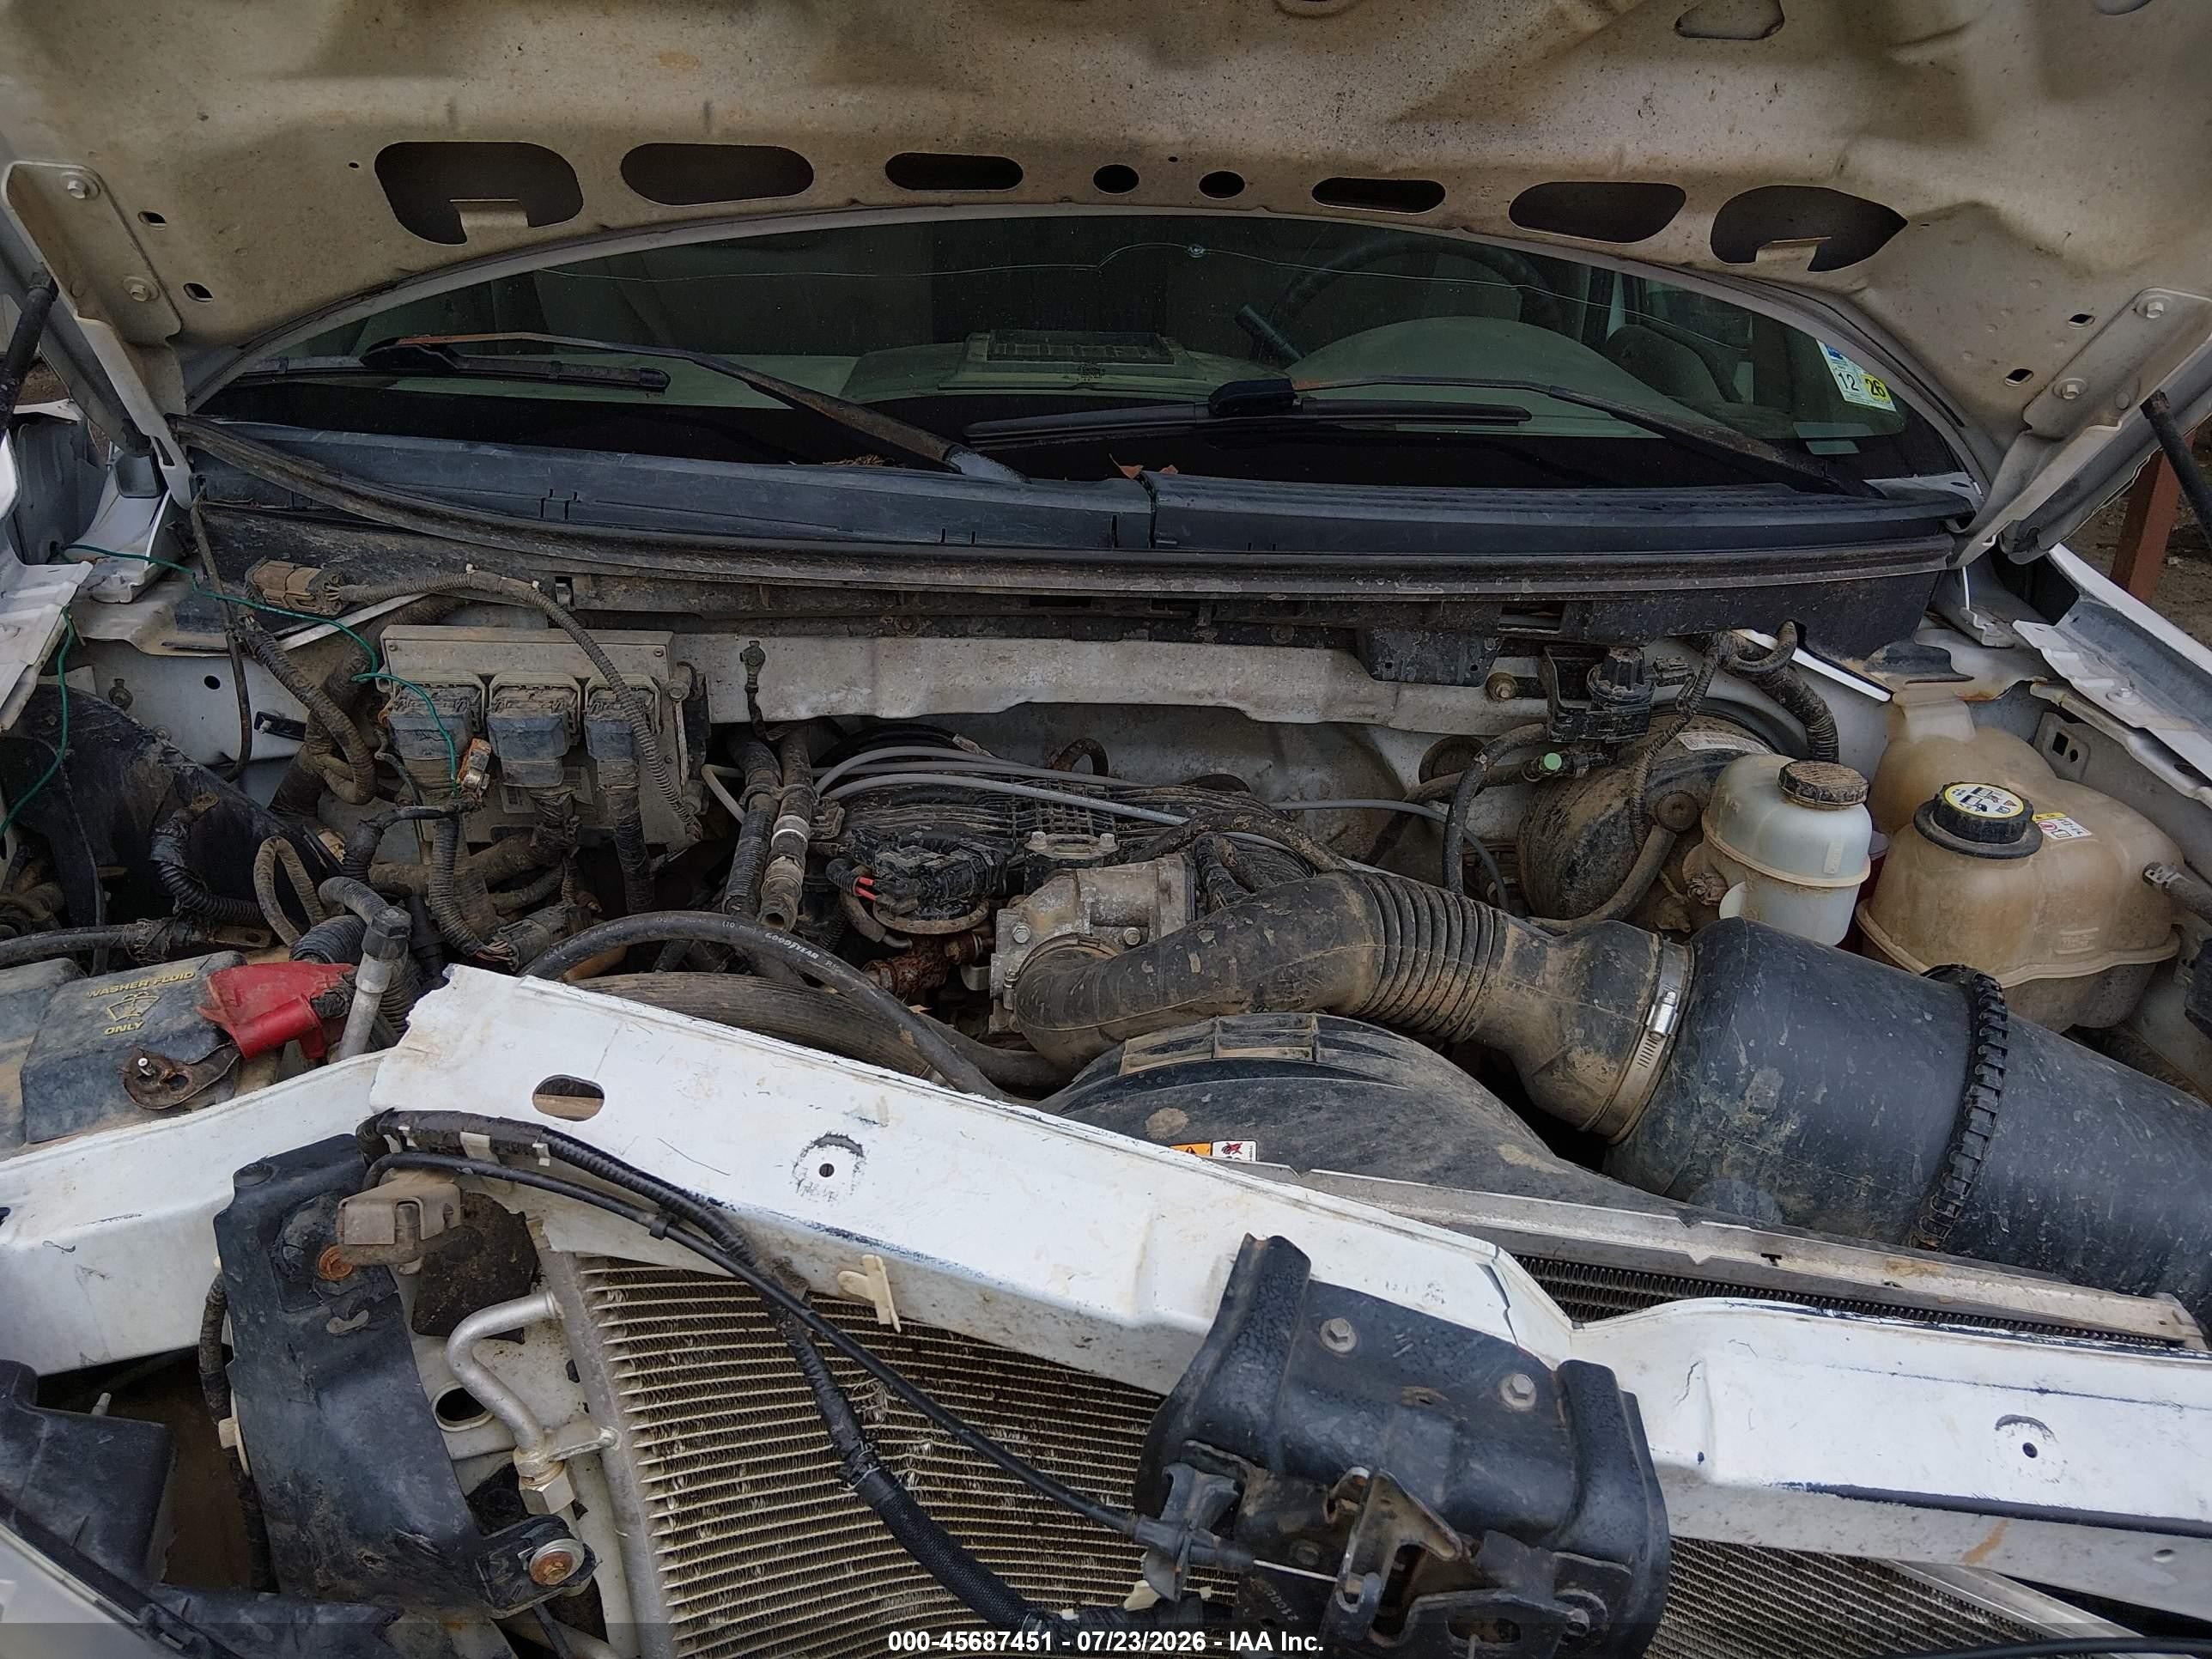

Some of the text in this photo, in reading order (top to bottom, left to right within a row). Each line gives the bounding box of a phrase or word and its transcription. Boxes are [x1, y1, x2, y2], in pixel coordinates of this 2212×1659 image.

[1838, 371, 1860, 392] 12
[1864, 378, 1887, 398] 26
[764, 932, 820, 960] GOODYEAR
[88, 971, 196, 998] WASHER FLUID
[104, 1020, 145, 1036] ONLY
